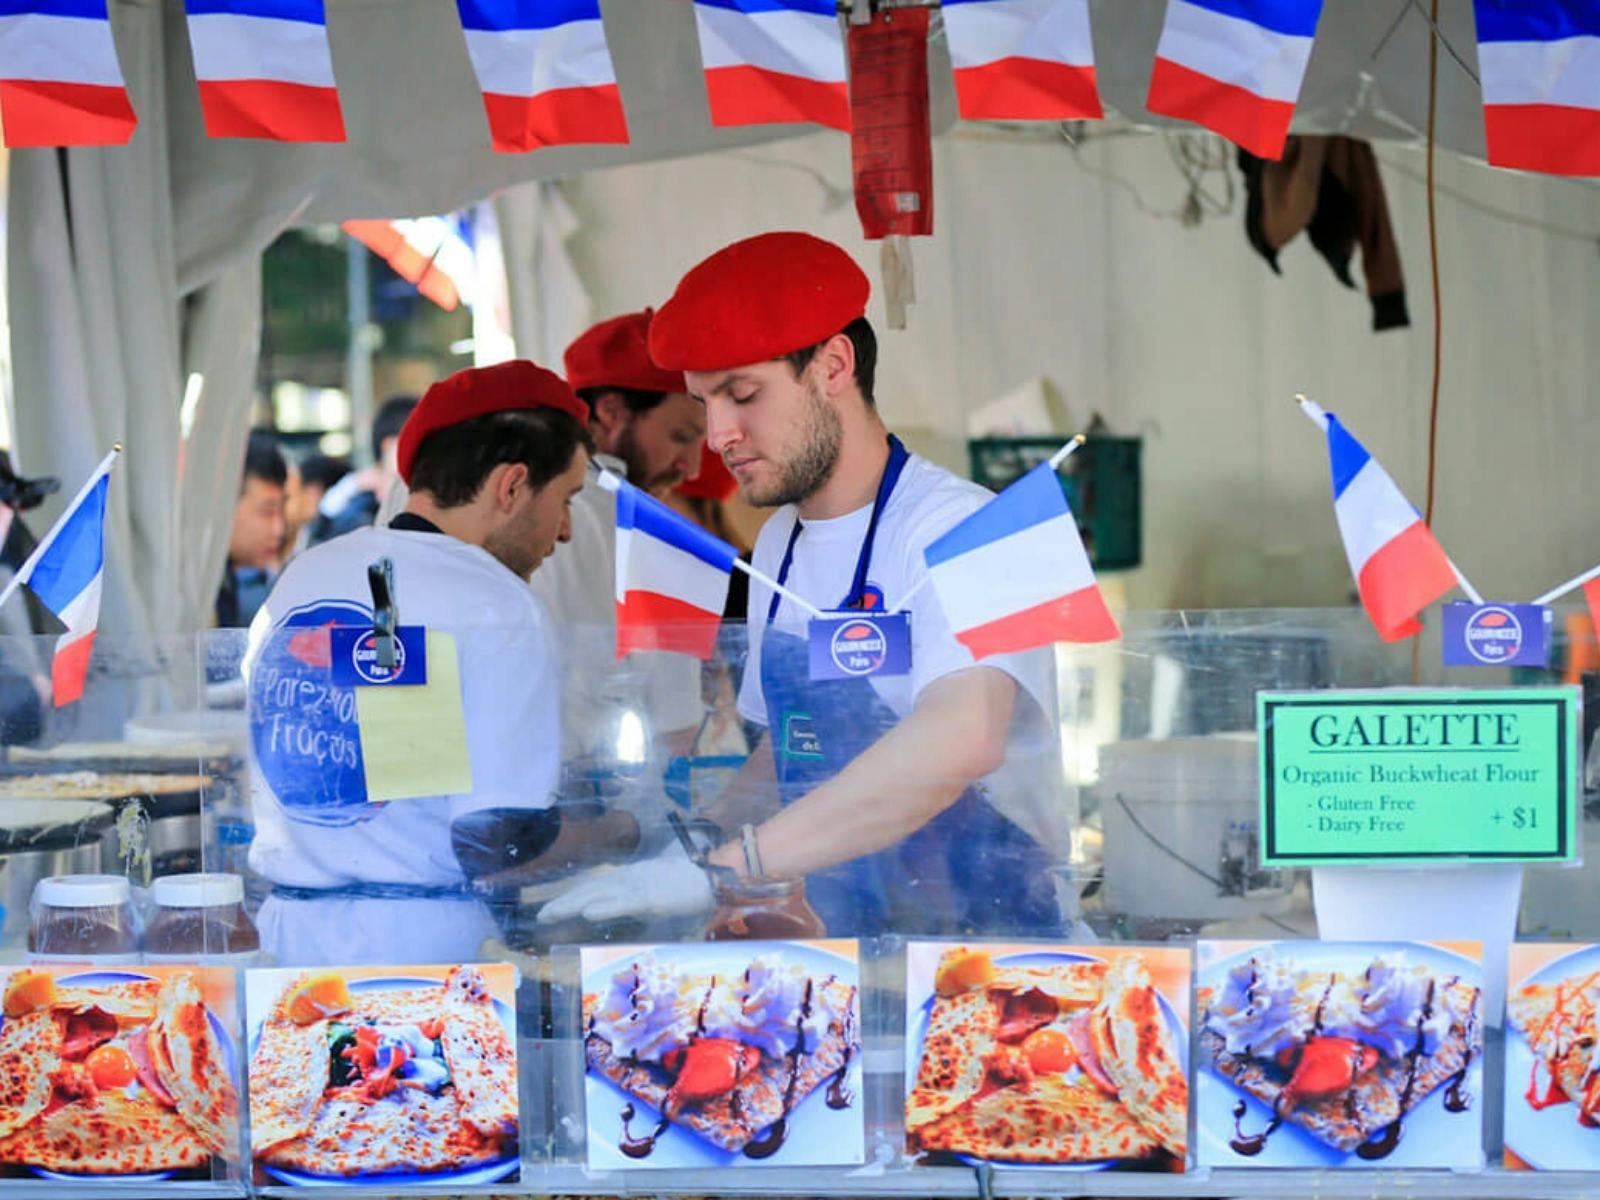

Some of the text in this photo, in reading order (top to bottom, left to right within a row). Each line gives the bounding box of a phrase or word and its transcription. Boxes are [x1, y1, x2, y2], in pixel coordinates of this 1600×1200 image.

[1310, 712, 1520, 748] GALETTE
[1283, 763, 1540, 786] Organic Buckwheat Flour
[1317, 795, 1373, 811] Gluten
[1379, 795, 1416, 811] Free
[1317, 816, 1363, 834] Dairy
[1369, 815, 1406, 832] Free
[1512, 806, 1539, 829] $1
